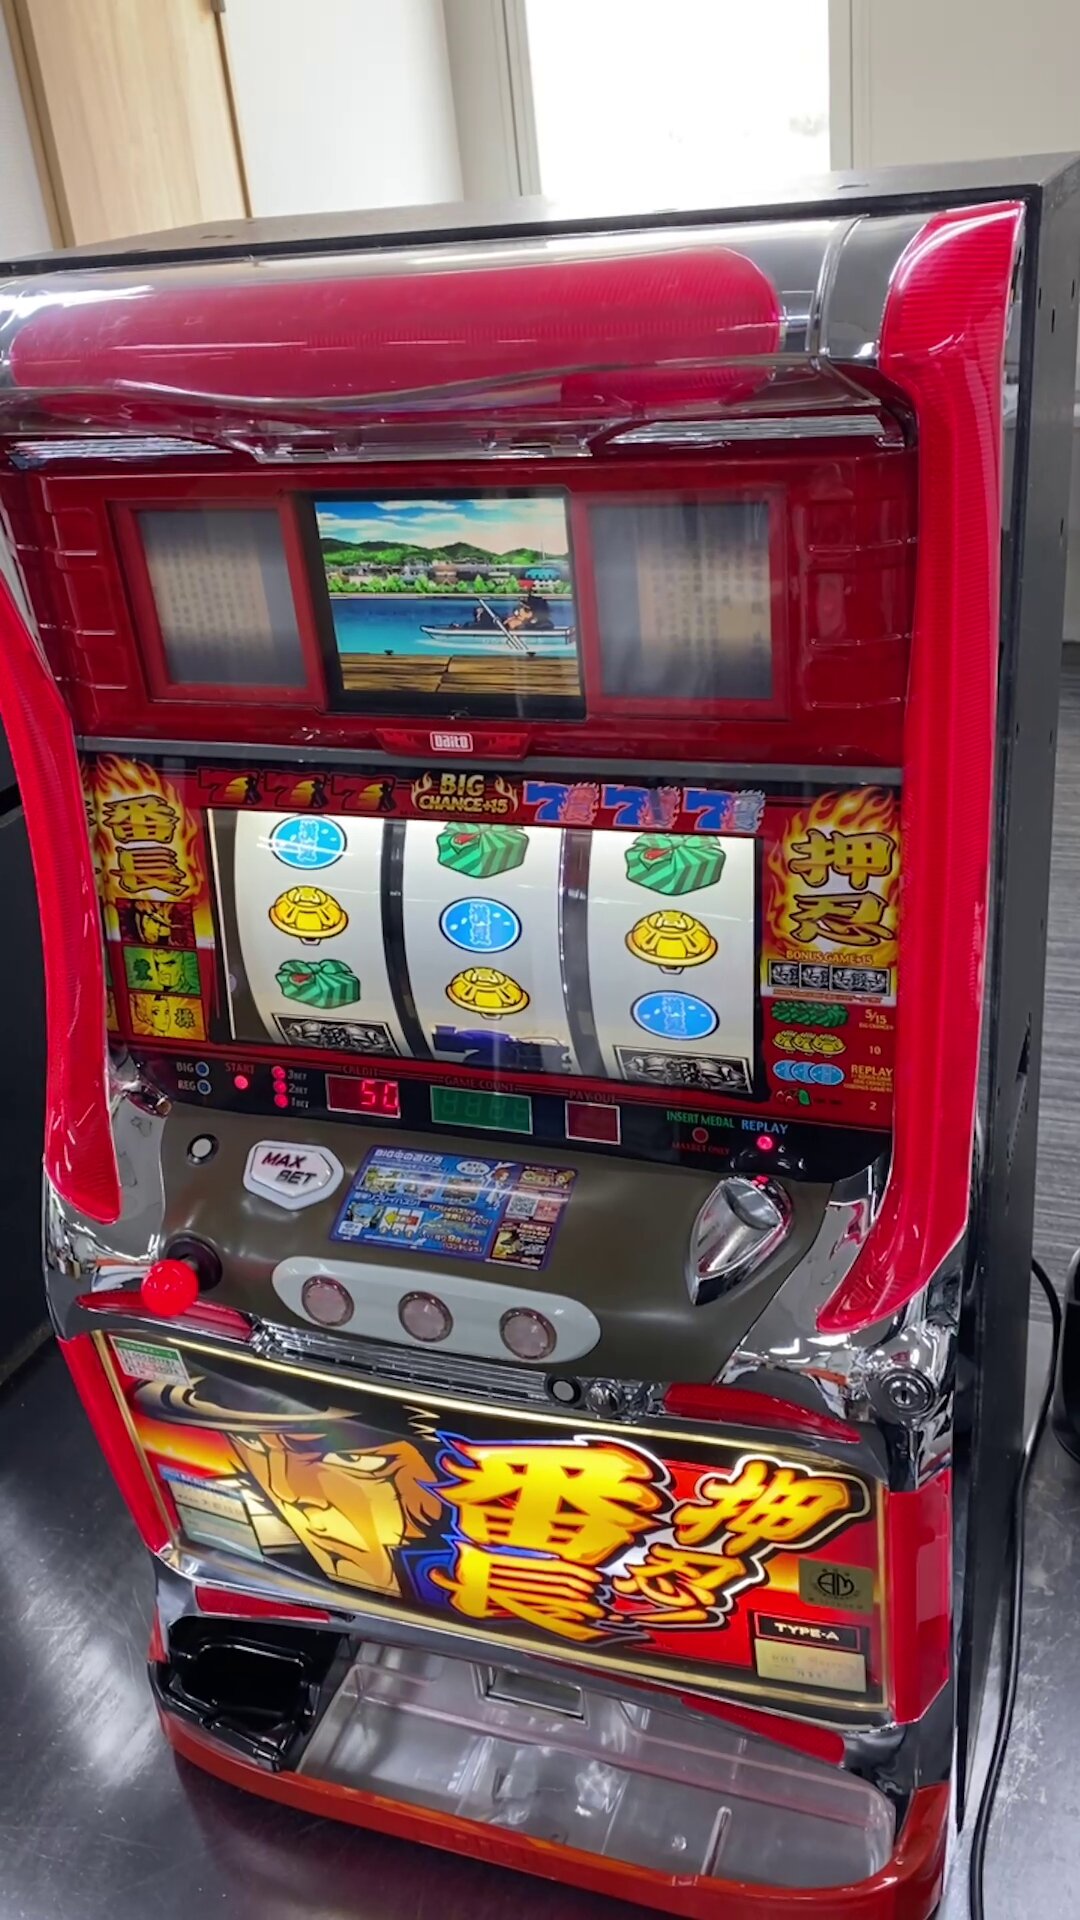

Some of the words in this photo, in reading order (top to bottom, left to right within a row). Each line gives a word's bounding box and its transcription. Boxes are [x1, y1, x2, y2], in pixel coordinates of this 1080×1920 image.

[440, 772, 485, 797] BIG
[102, 794, 190, 897] 番長
[788, 828, 897, 947] 押忍
[786, 950, 822, 962] BONUS
[869, 1045, 882, 1056] 10
[176, 1062, 194, 1074] BIG
[225, 1062, 255, 1075] START
[850, 1064, 893, 1077] REPLAY
[178, 1079, 196, 1091] REG
[444, 1075, 477, 1089] GAME
[479, 1079, 514, 1093] COUNT
[360, 1079, 398, 1108] 50
[869, 1100, 877, 1111] 2
[666, 1110, 699, 1125] INSERT
[701, 1114, 735, 1129] MEDAL
[741, 1119, 788, 1135] REPLAY
[261, 1151, 307, 1169] MAX
[275, 1169, 317, 1185] BET
[427, 1440, 666, 1641] 番長
[610, 1459, 851, 1624] 押忍
[774, 1622, 840, 1641] TYPE-A
